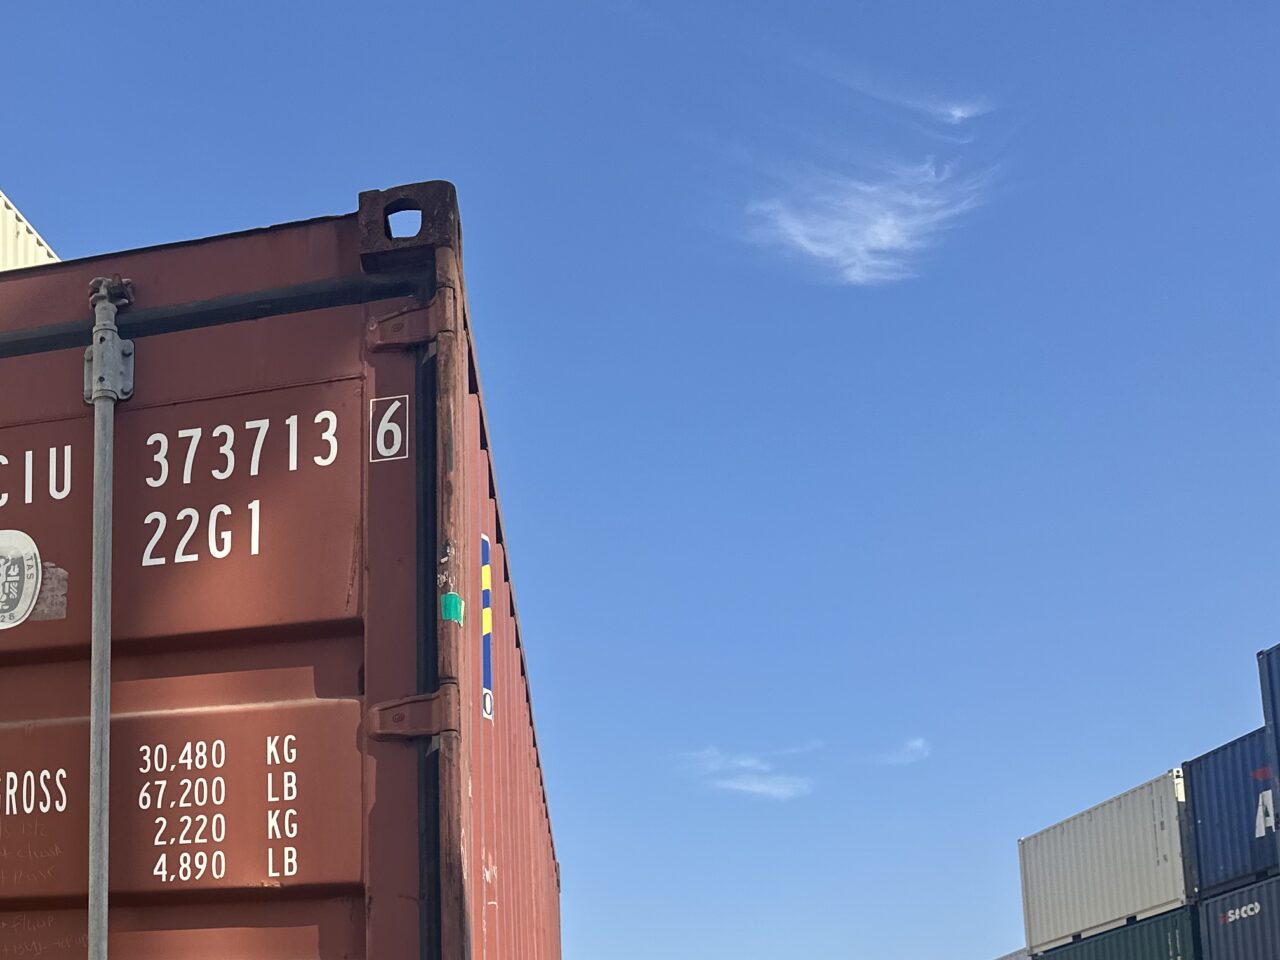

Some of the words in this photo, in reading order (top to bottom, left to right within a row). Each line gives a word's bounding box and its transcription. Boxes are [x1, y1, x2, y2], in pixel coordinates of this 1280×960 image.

[145, 411, 338, 488] 373713
[376, 400, 401, 456] 6
[142, 499, 260, 566] 22G1
[139, 739, 226, 774] 30,480
[266, 735, 297, 765] KG
[138, 776, 226, 811] 67,200
[267, 771, 298, 803] LB
[153, 813, 226, 847] 2,220
[267, 809, 298, 840] KG
[153, 850, 226, 883] 4,890
[267, 846, 298, 877] LB
